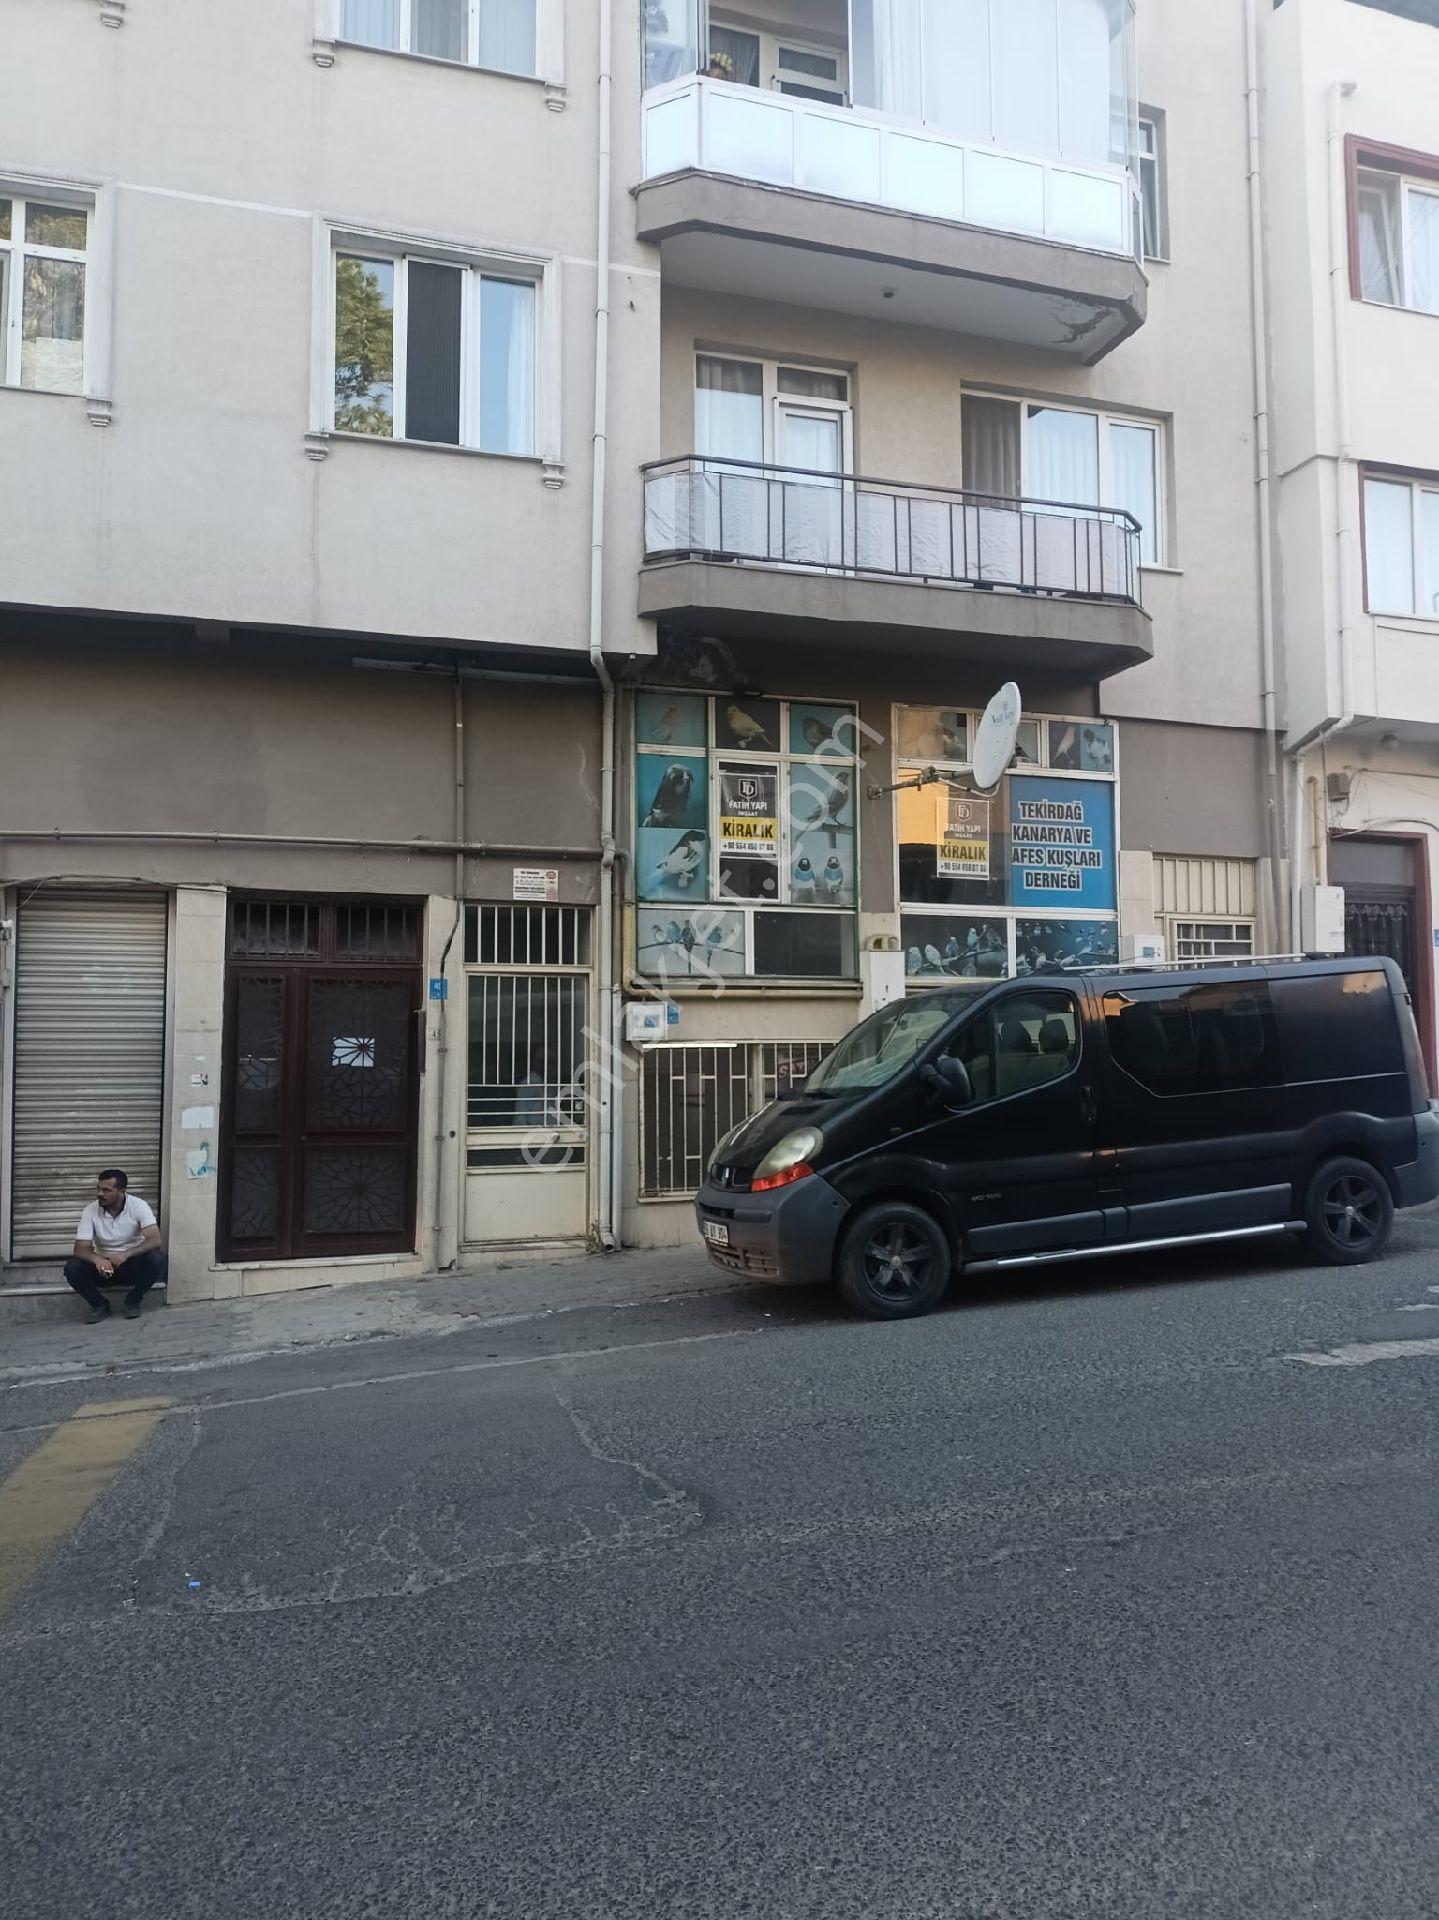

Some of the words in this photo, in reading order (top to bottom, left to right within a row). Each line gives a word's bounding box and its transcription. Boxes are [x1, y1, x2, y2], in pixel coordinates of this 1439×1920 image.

[750, 801, 768, 811] YAPI
[1019, 799, 1083, 821] TEKİRDAĞ
[722, 819, 774, 839] KİRALIK
[966, 824, 981, 833] YAPI
[1012, 824, 1073, 843] KANARYA
[1075, 828, 1091, 844] VE
[940, 841, 986, 861] KİRALIK
[1046, 849, 1101, 868] KUŞLARI
[1024, 870, 1081, 890] DERNEĞİ
